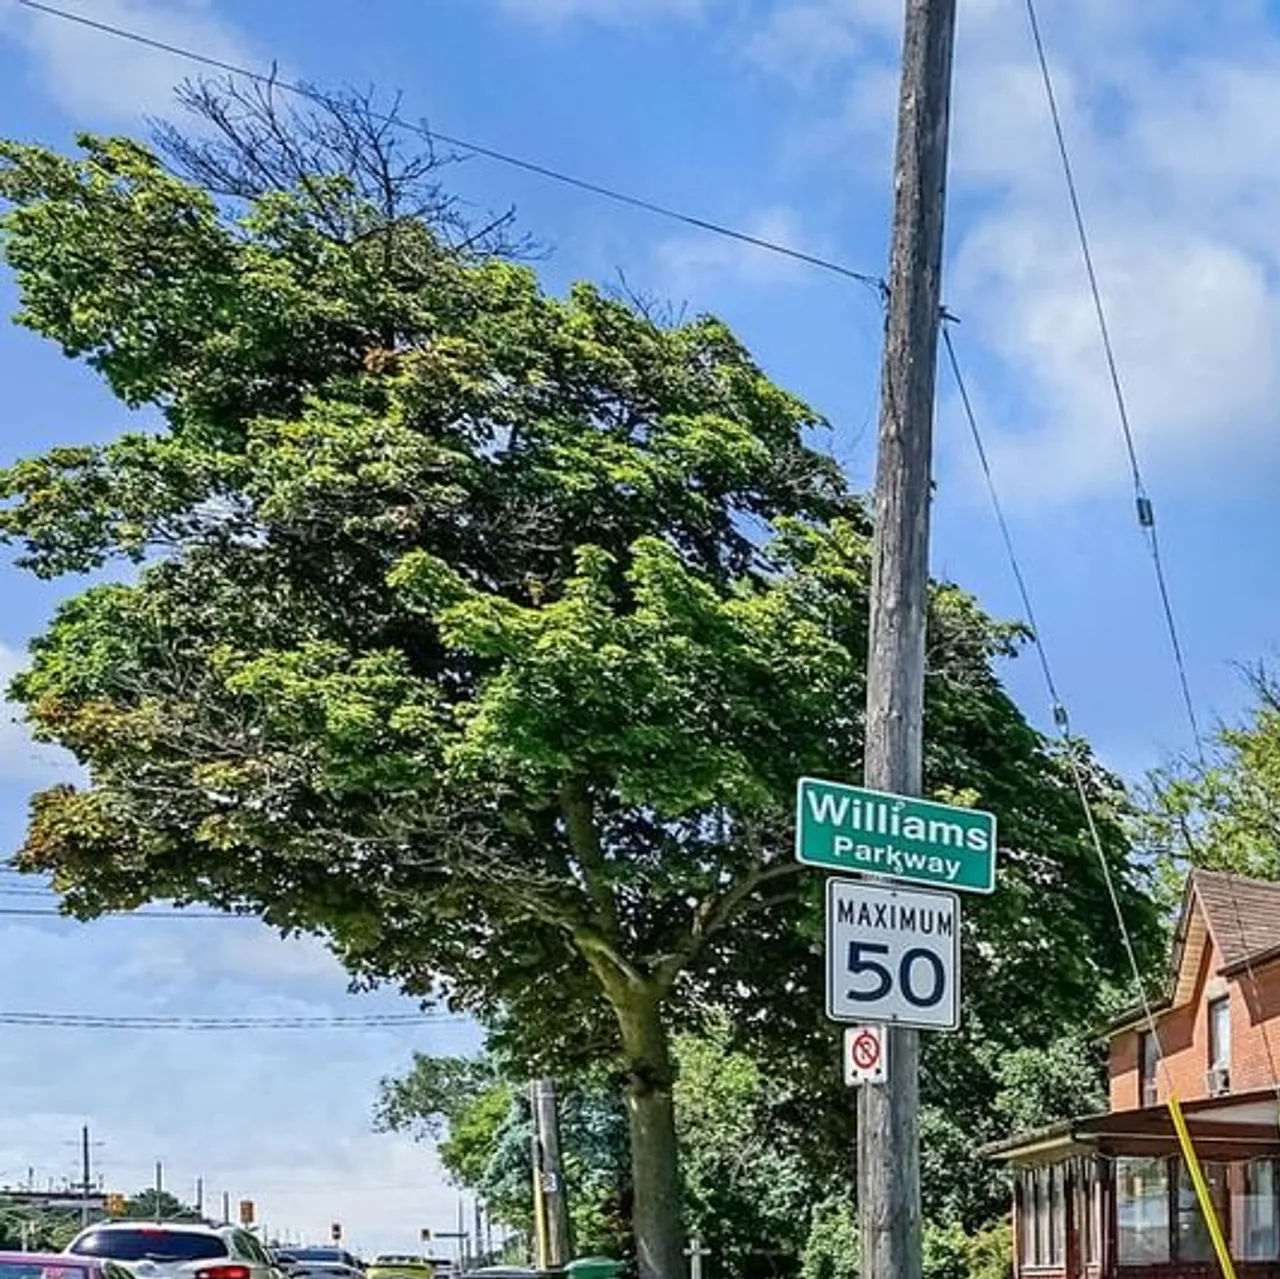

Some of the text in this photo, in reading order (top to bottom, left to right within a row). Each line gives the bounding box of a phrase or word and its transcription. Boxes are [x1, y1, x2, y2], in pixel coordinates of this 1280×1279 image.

[807, 789, 988, 851] Williams
[833, 836, 960, 879] Parkway
[837, 899, 951, 937] MAXIMUM
[846, 941, 946, 1008] 50
